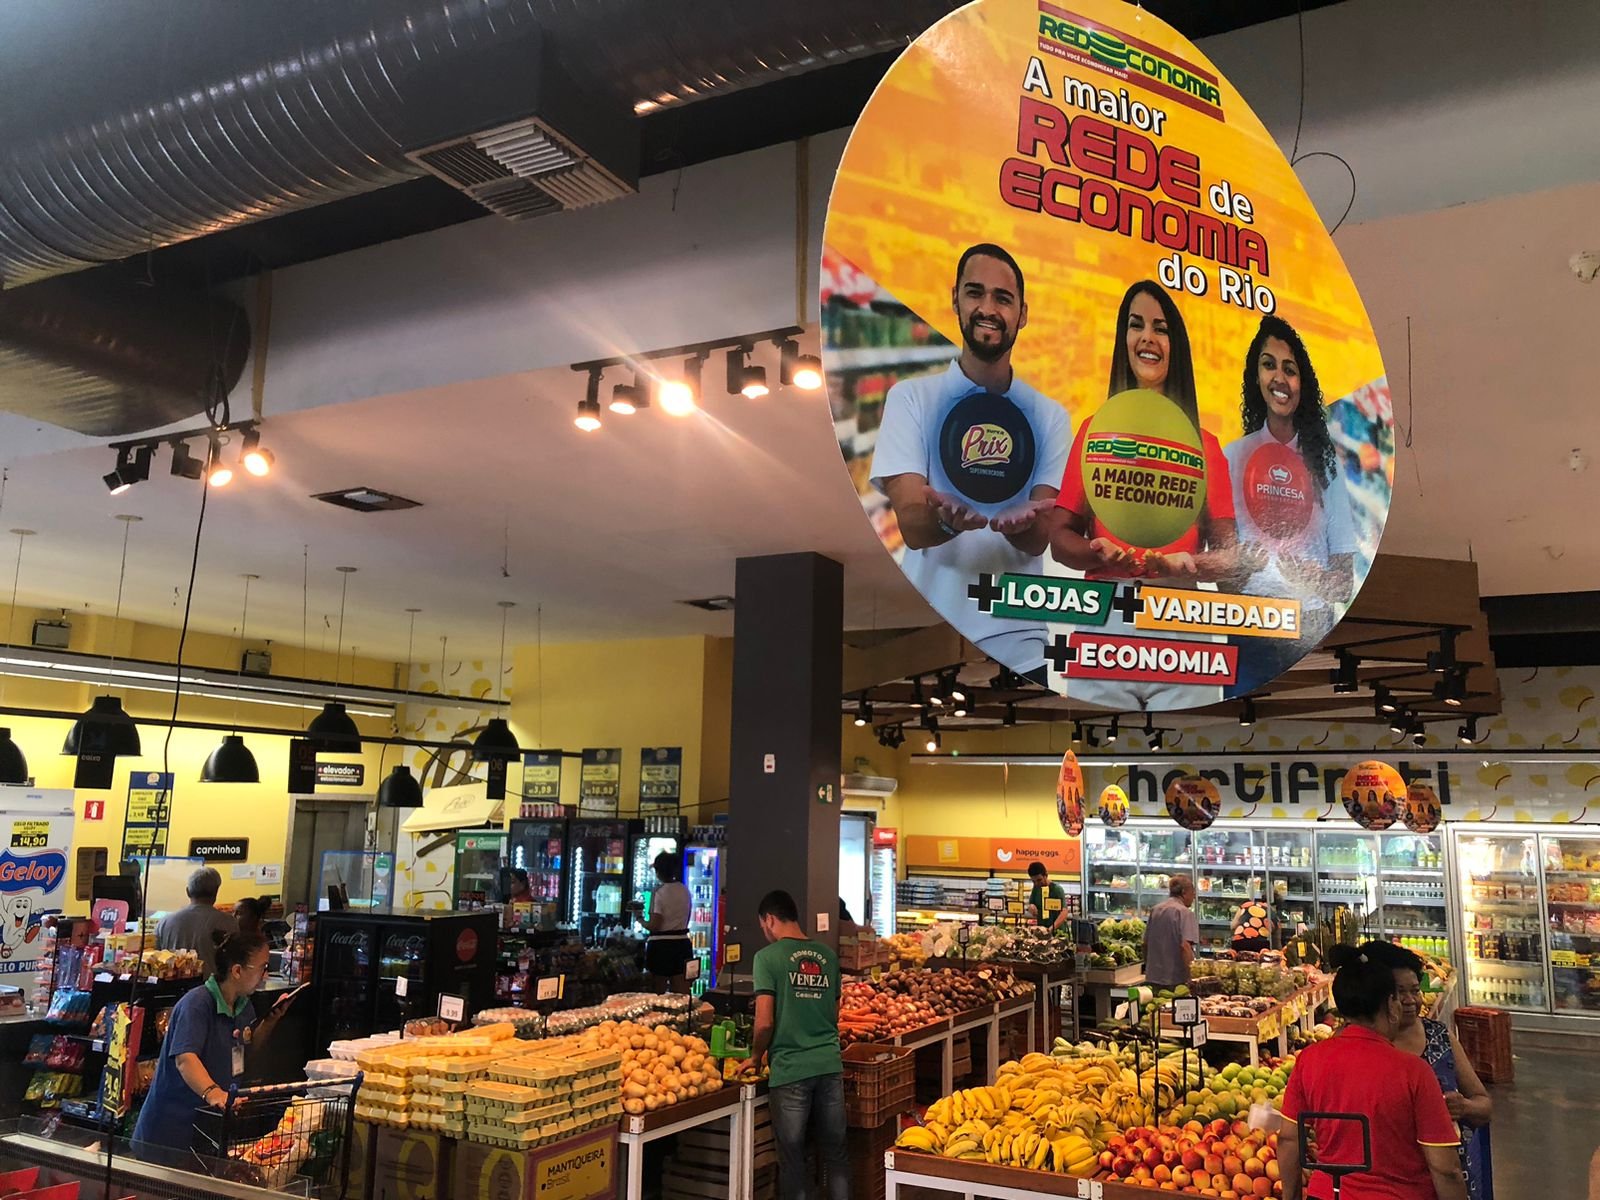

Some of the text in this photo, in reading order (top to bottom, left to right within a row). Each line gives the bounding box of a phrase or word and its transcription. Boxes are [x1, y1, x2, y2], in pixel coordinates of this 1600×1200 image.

[1039, 42, 1054, 52] TUDO
[1054, 47, 1066, 57] PRA
[1067, 52, 1080, 62] VOCÊ
[1081, 57, 1114, 74] ECONOMIZAR
[1023, 56, 1166, 137] A maior
[1016, 95, 1254, 224] REDE de
[999, 157, 1270, 277] ECONOMIA
[1157, 253, 1277, 315] do Rio
[962, 424, 1008, 461] Prix
[1091, 467, 1198, 494] A MAIOR REDE
[1256, 483, 1305, 501] PRINCESA
[1094, 483, 1195, 509] DE ECONOMIA
[1006, 581, 1101, 616] LOJAS
[1146, 595, 1298, 631] VARIEDADE
[1079, 643, 1231, 677] ECONOMIA
[20, 836, 46, 848] 14,90
[196, 844, 241, 854] carrinhos
[1015, 847, 1059, 858] happy eggs
[0, 860, 63, 886] Geloy
[789, 949, 828, 965] PROMOTOR
[788, 971, 830, 988] VENEZA
[547, 1147, 605, 1177] MANTIQUEIRA
